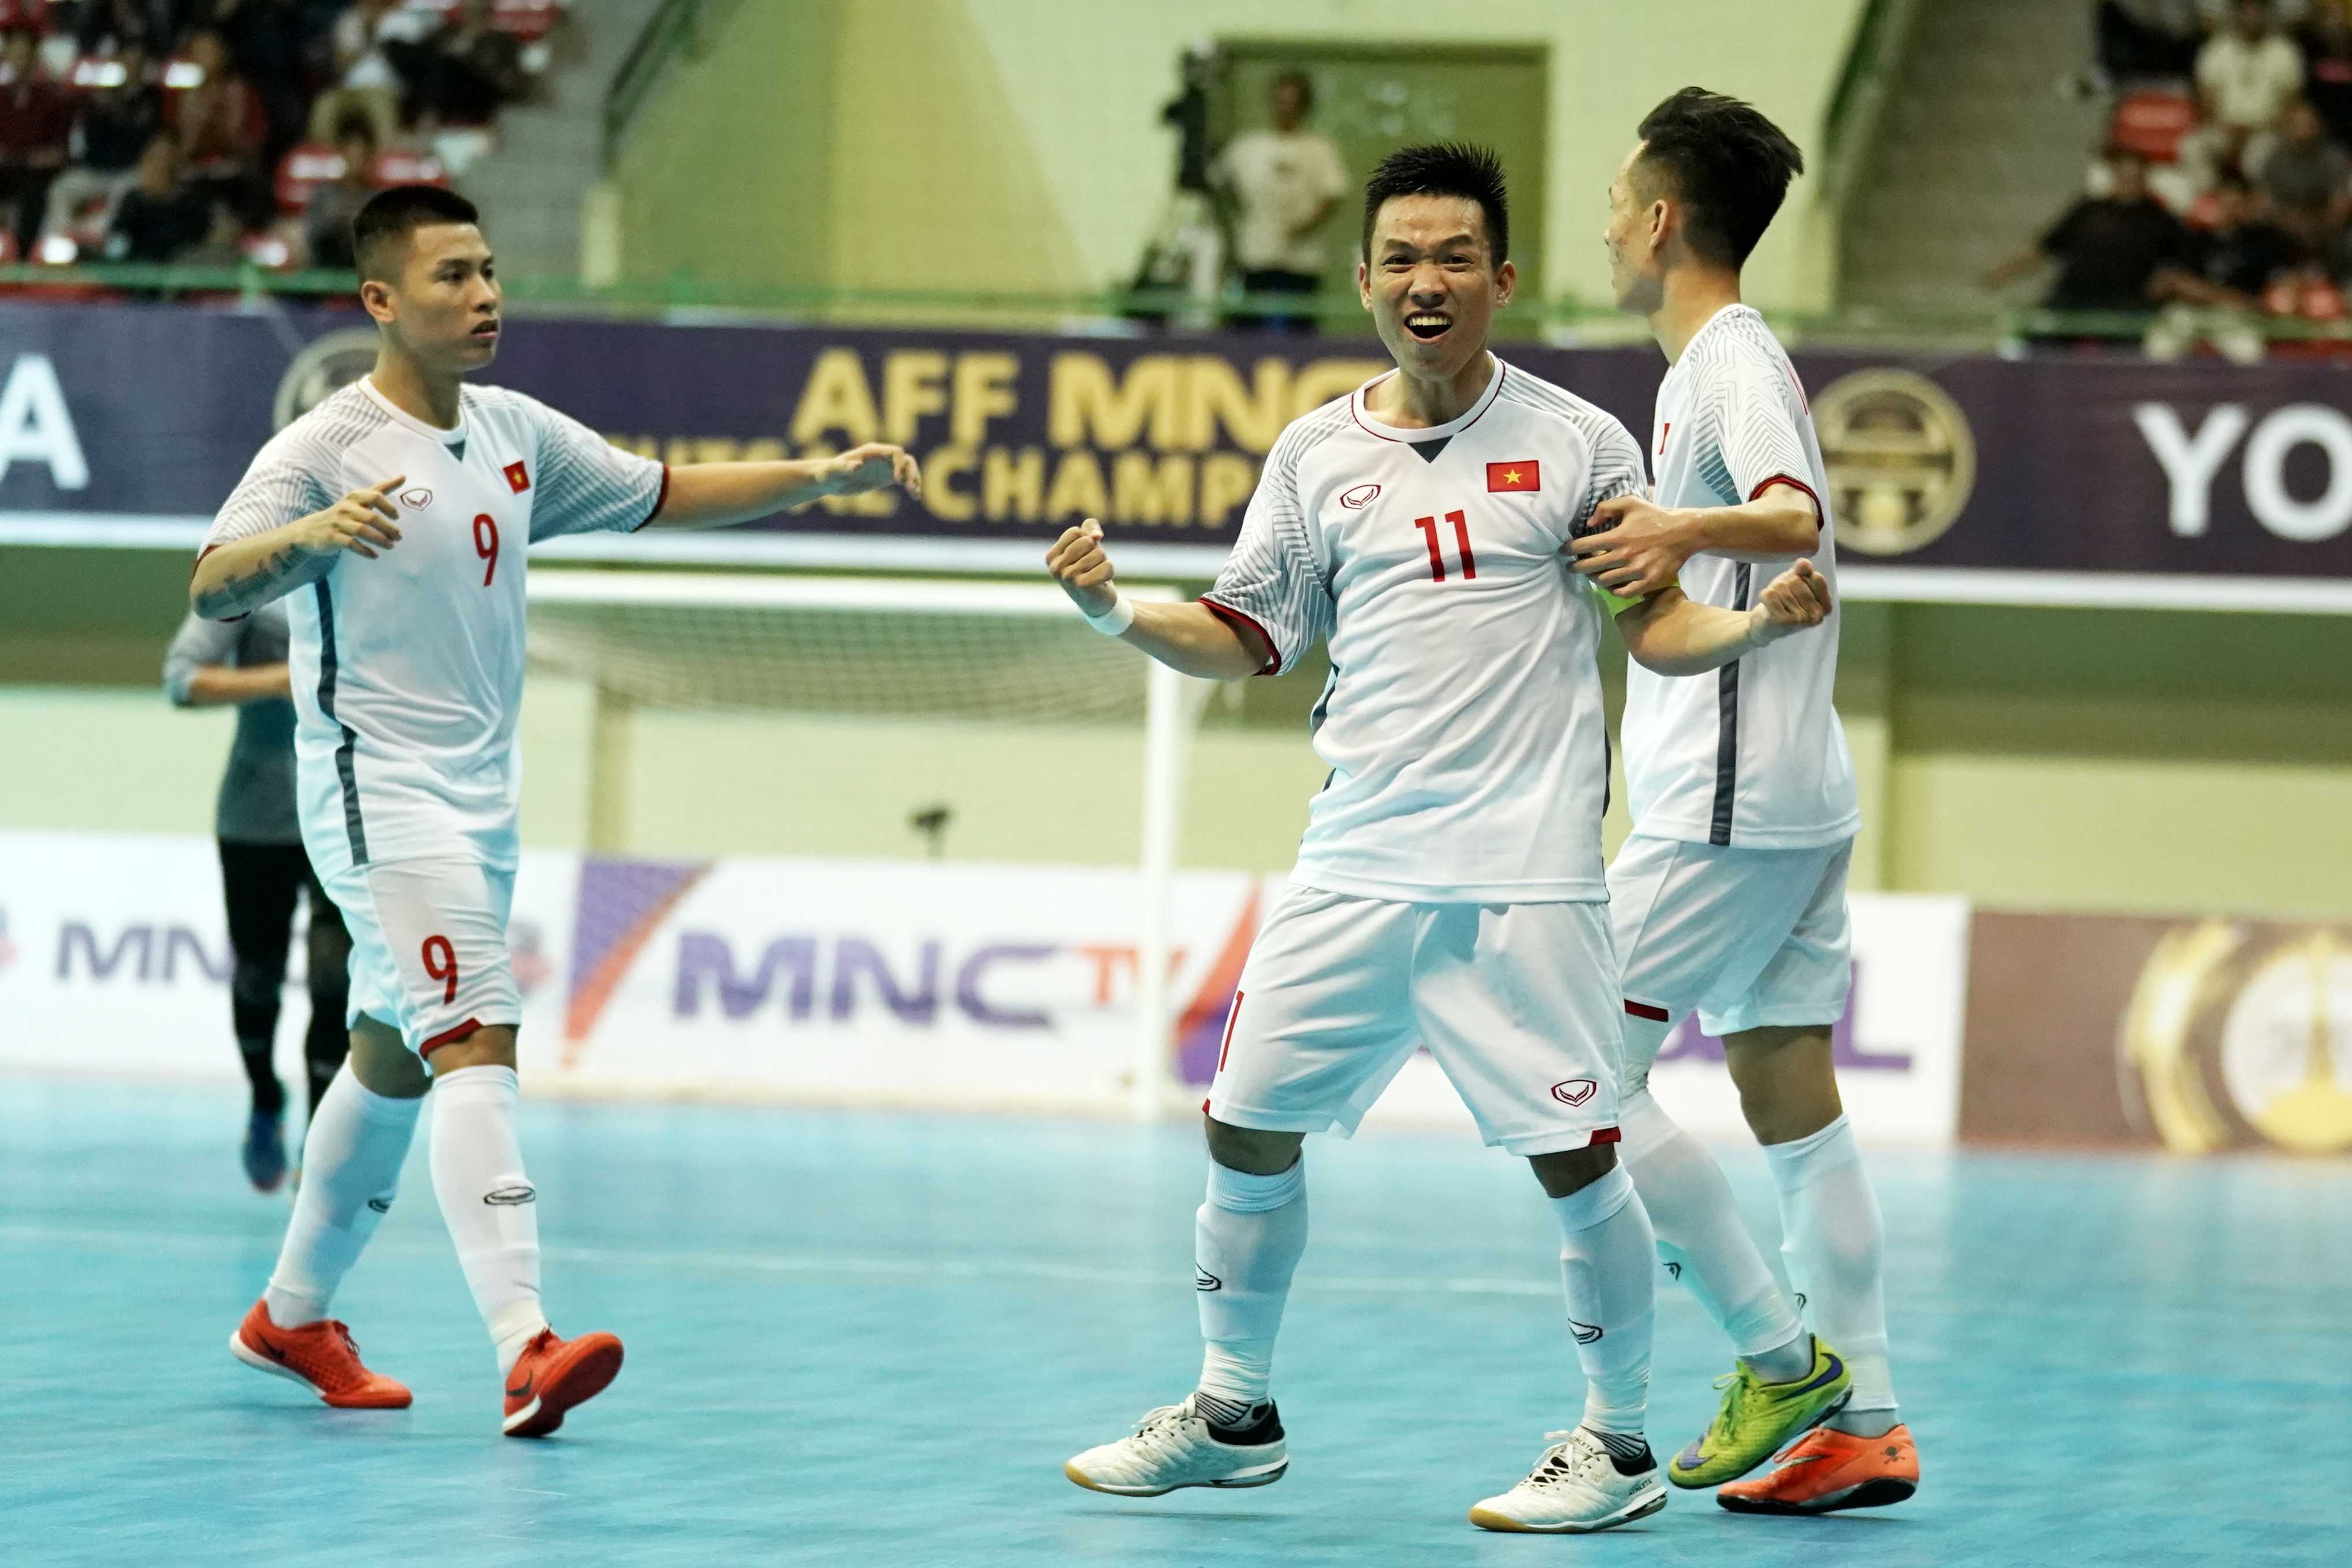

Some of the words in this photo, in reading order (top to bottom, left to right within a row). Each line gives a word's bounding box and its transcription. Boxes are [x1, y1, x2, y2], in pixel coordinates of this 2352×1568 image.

[788, 349, 1021, 448] AFF
[2134, 401, 2352, 542] YO
[473, 514, 499, 587] 9
[1414, 509, 1476, 583] 11
[421, 935, 458, 1005] 9
